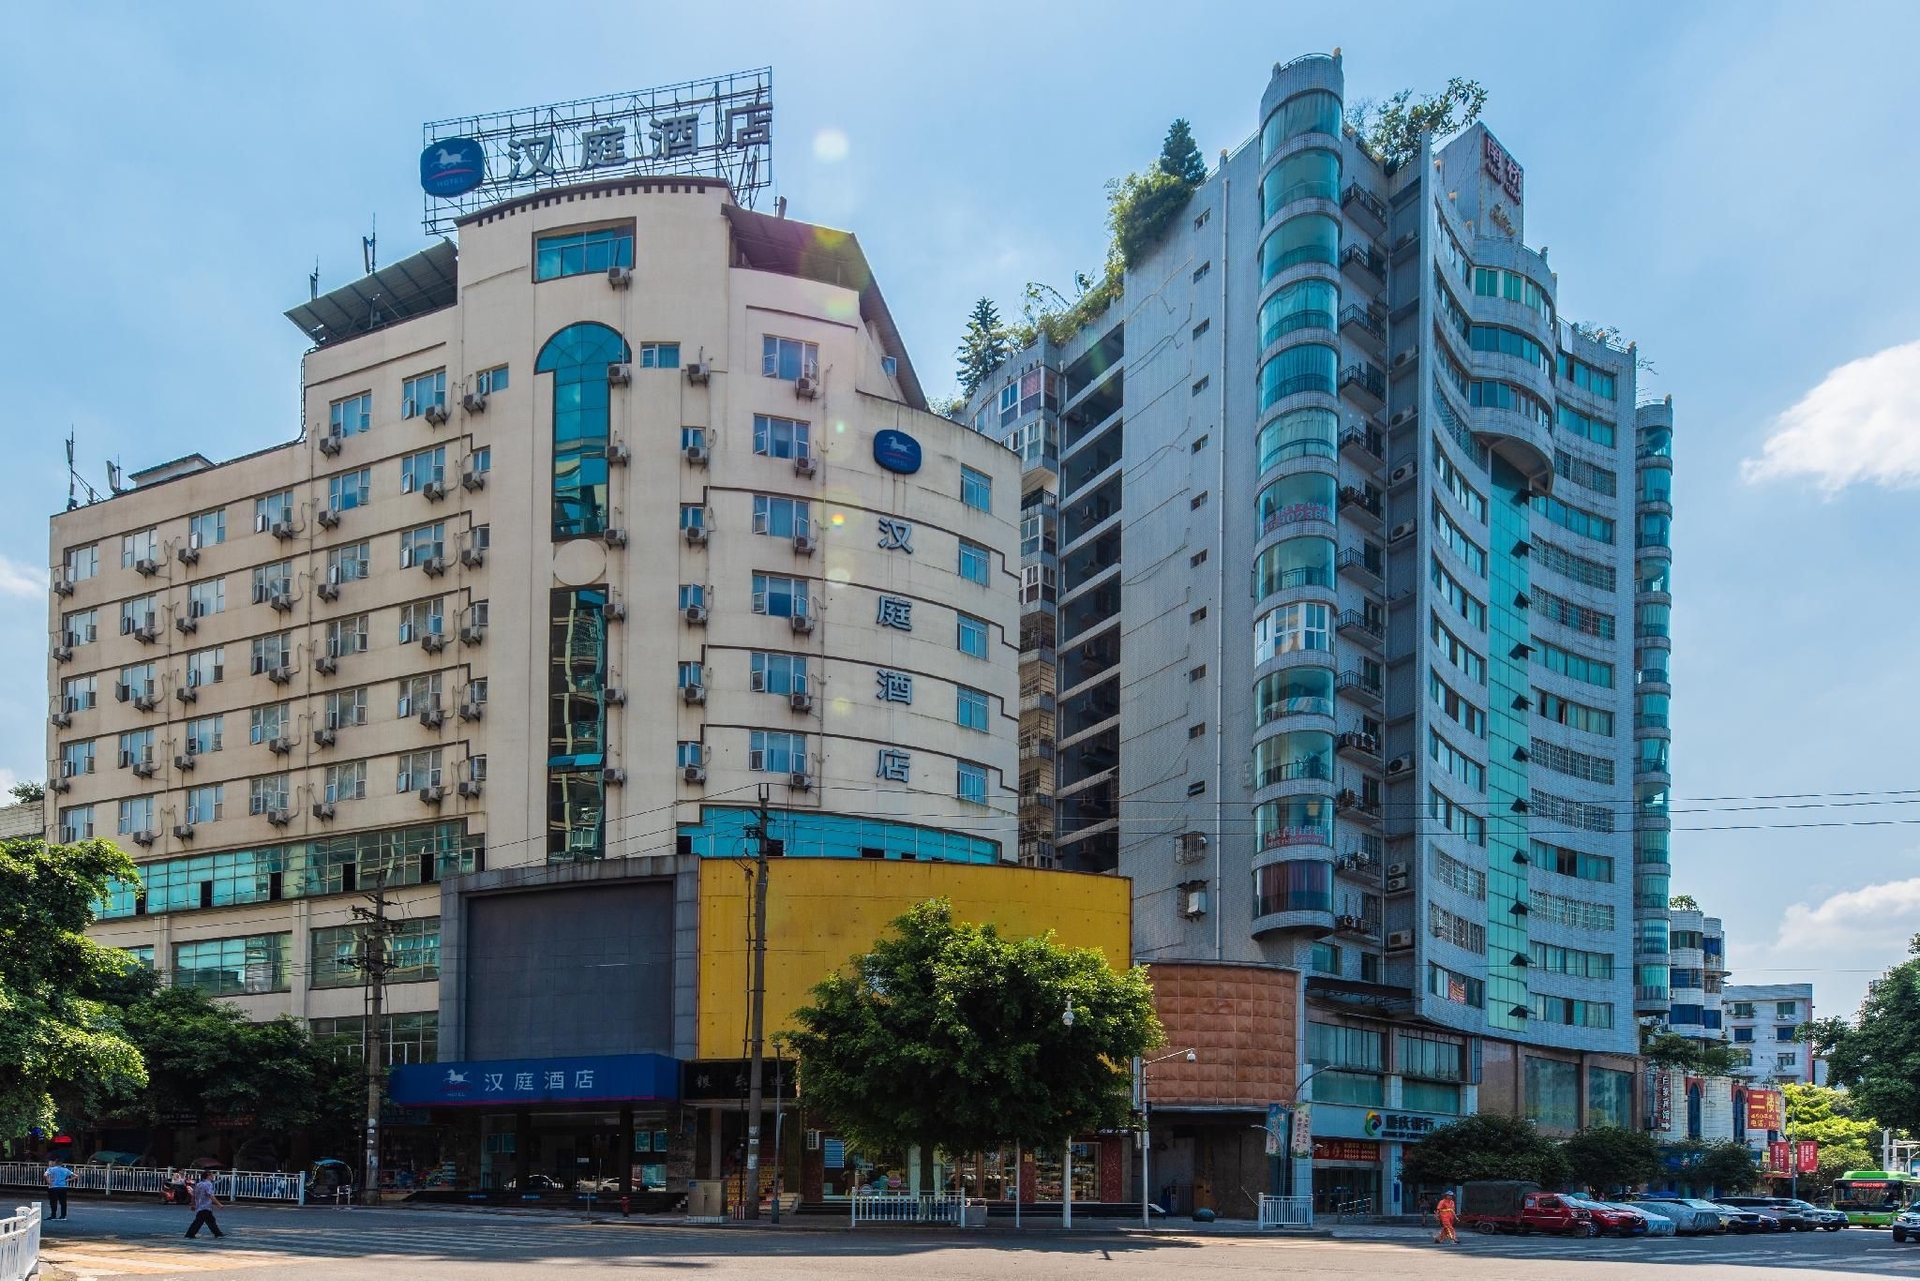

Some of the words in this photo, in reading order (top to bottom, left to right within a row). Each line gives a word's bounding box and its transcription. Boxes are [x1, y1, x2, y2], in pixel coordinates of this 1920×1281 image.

[507, 102, 773, 181] 汉庭酒店
[436, 176, 465, 187] HOTEL
[876, 517, 914, 783] 汉庭酒店
[484, 1069, 595, 1092] 汉庭酒店
